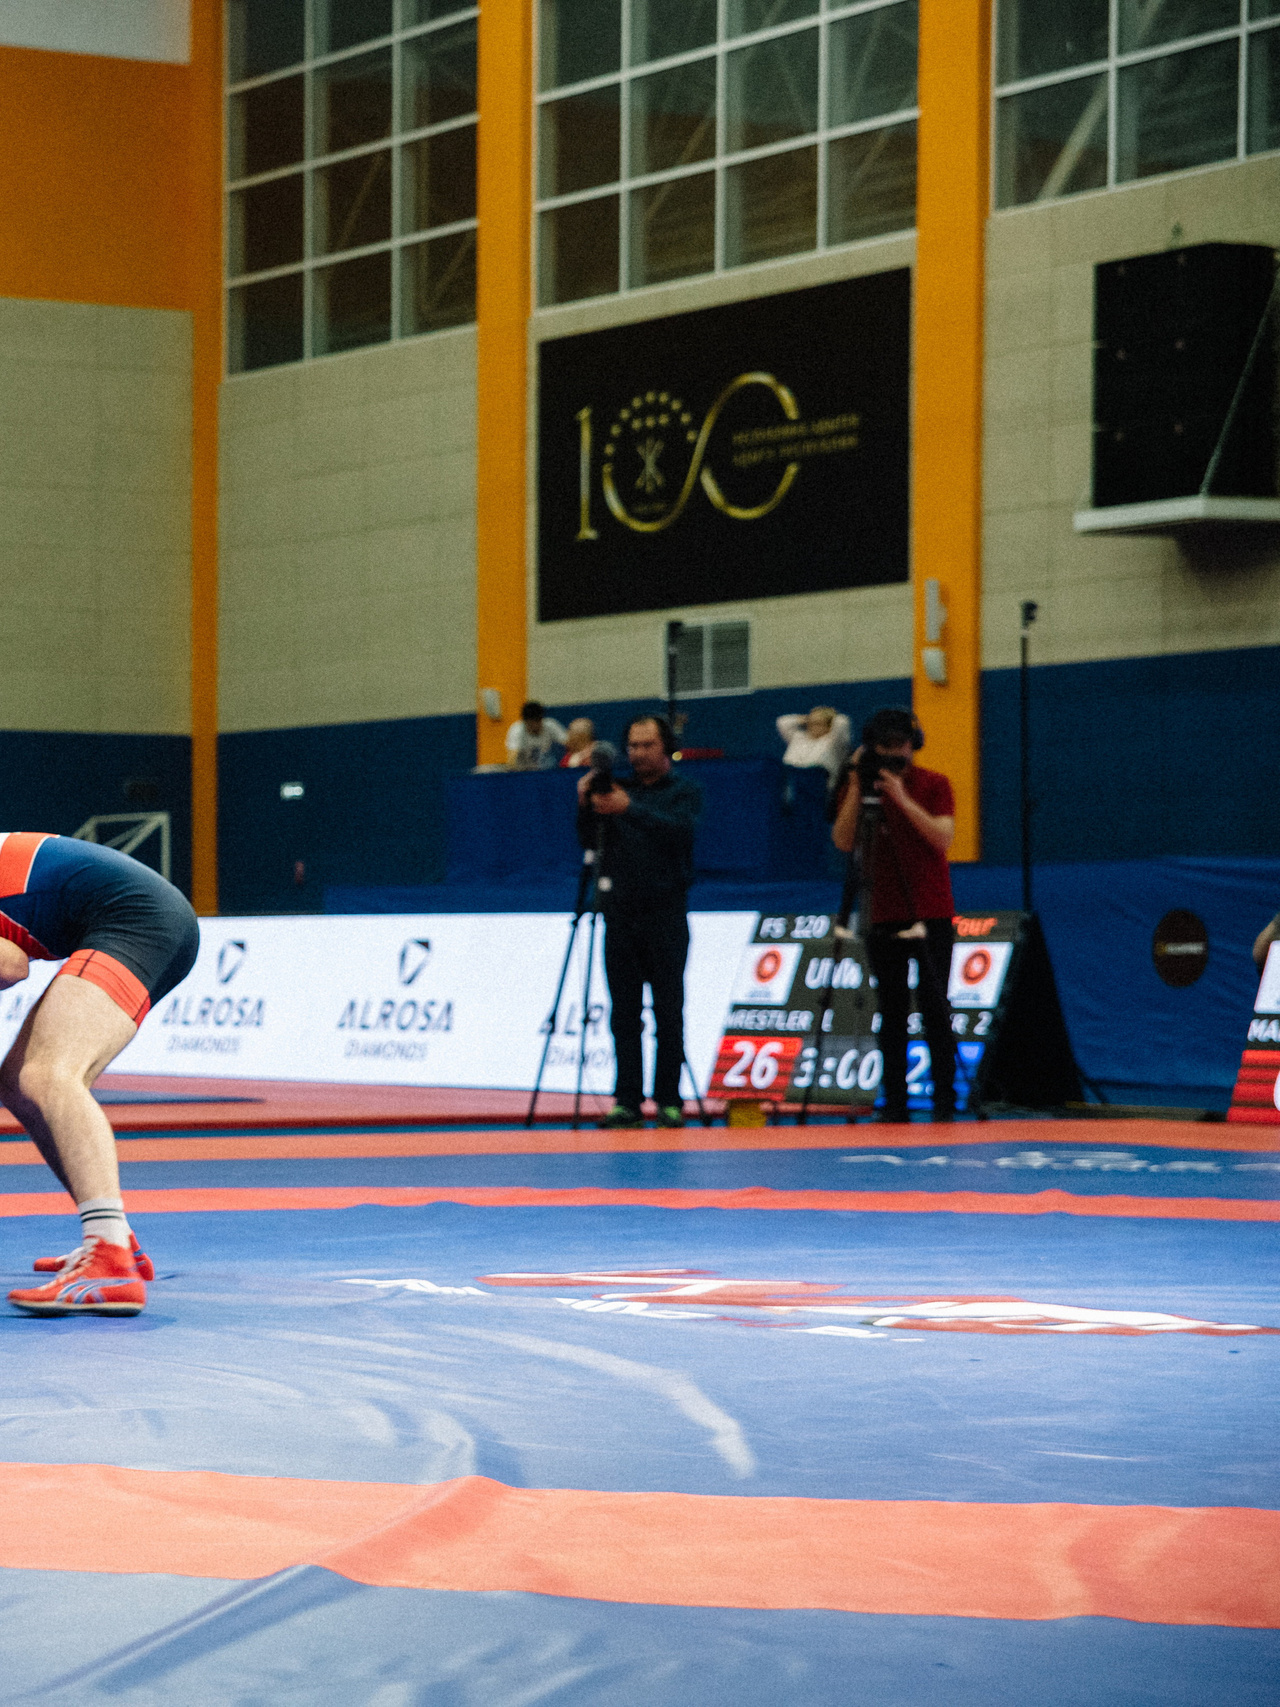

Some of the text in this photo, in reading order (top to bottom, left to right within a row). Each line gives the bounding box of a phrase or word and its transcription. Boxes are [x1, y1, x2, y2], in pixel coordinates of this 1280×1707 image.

[790, 914, 831, 939] 120
[162, 996, 265, 1027] ALROSA
[337, 998, 453, 1033] ALROSA
[722, 1040, 784, 1090] 26
